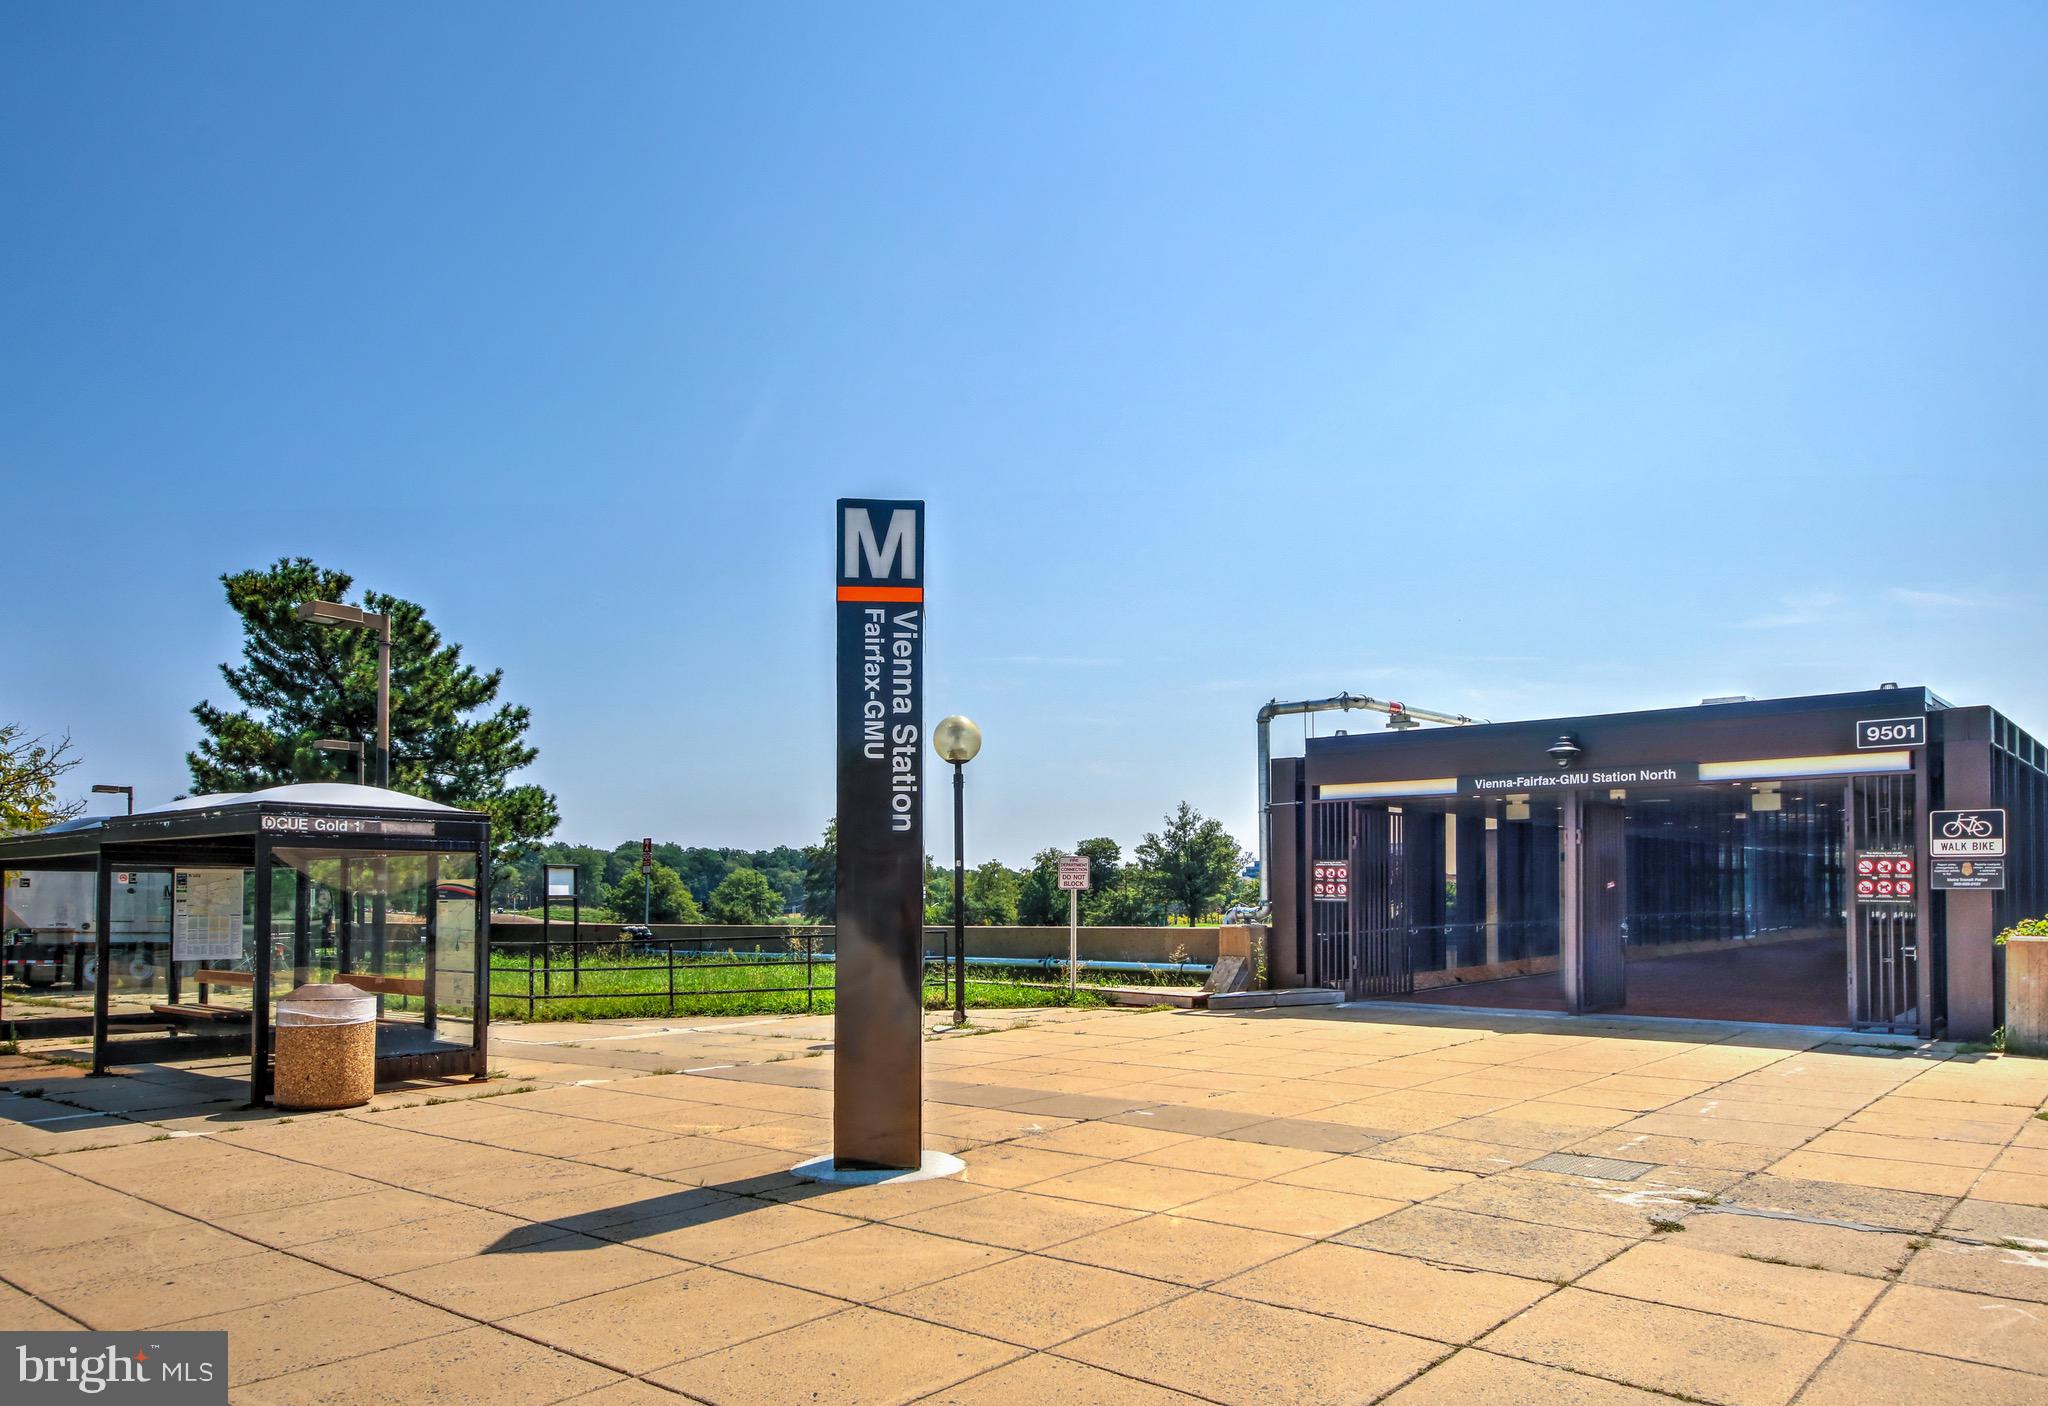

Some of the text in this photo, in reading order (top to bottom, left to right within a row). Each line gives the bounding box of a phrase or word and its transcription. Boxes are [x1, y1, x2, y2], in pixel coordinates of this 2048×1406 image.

[844, 507, 917, 580] M
[863, 608, 886, 760] Fairfax-GMU
[892, 609, 919, 832] Vienna Station
[1866, 724, 1916, 742] 9501
[1474, 768, 1677, 790] Vienna-Fairfax-GMU Station North
[314, 818, 349, 832] Gold
[1940, 841, 1995, 851] WALK BIKE
